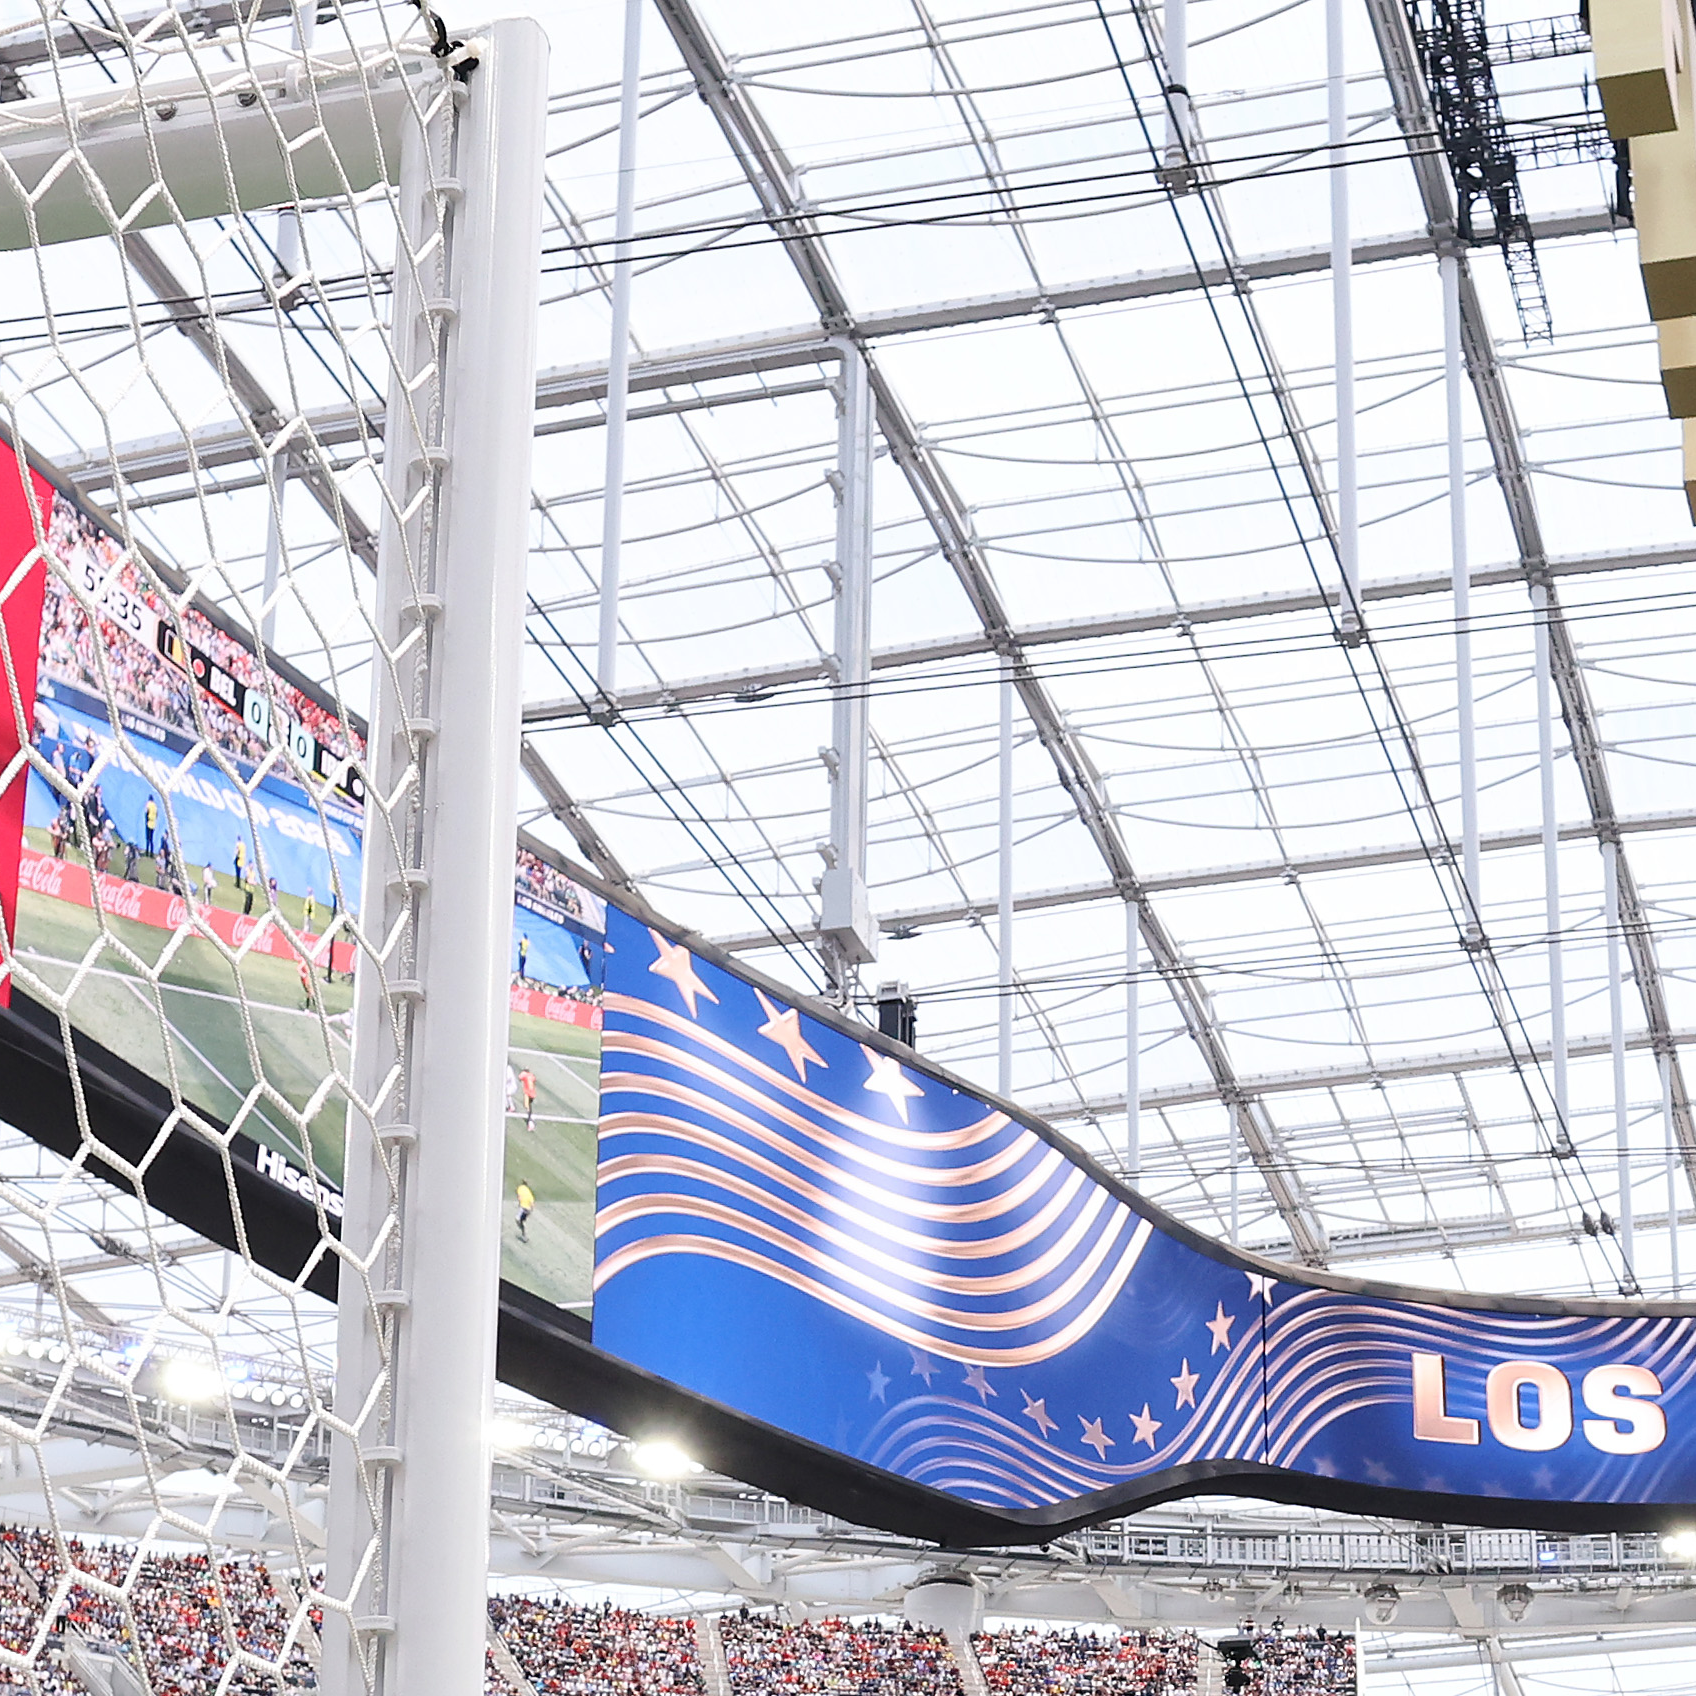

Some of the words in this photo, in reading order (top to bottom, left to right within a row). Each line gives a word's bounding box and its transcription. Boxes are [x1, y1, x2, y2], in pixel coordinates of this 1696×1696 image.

[84, 564, 143, 631] 5:35
[256, 1143, 344, 1218] Hisens
[1410, 1353, 1667, 1454] LOS
